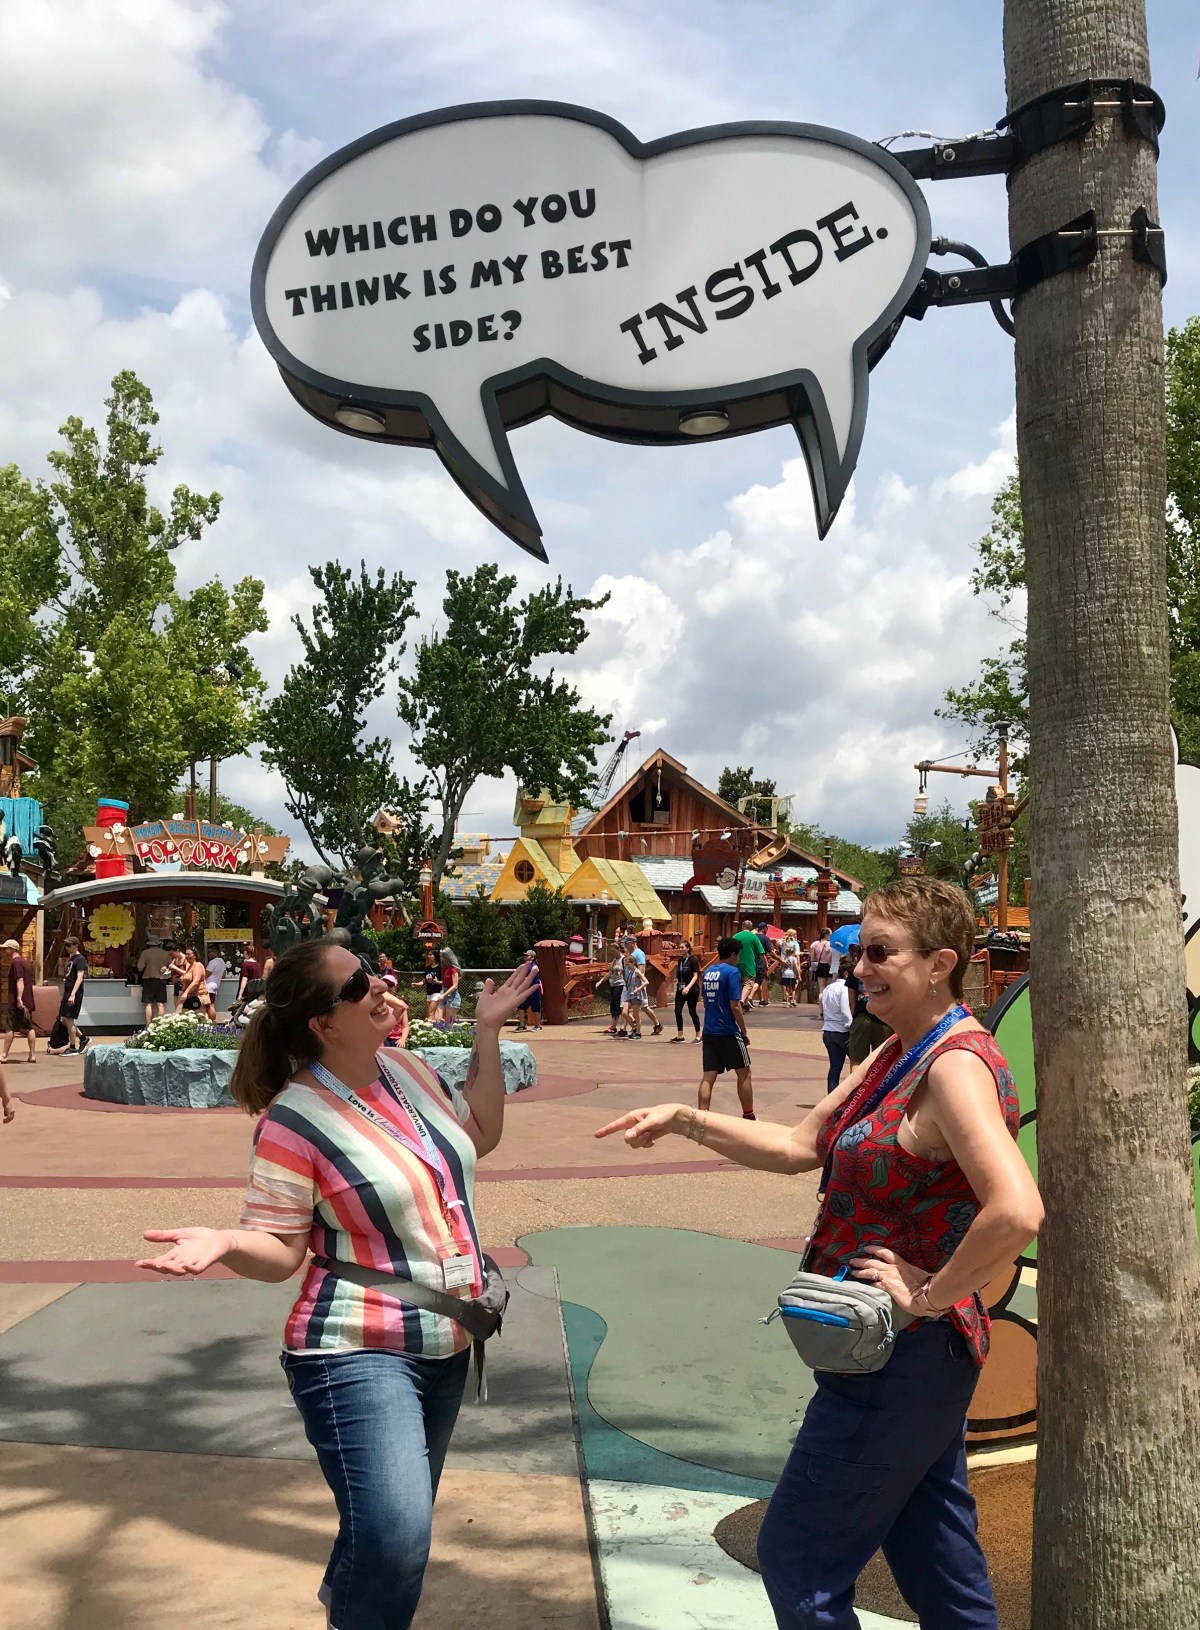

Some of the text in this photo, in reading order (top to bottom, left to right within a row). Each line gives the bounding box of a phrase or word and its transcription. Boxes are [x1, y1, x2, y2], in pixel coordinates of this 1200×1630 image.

[305, 189, 595, 256] WHICH DO YOU
[285, 240, 631, 316] THINK IS MY BEST
[620, 201, 888, 365] INSIDE.
[413, 310, 521, 352] SIDE?
[134, 823, 164, 840] POOP
[169, 821, 196, 835] DECK
[136, 839, 242, 872] POPCORN
[703, 971, 720, 981] 400
[703, 982, 719, 990] TEAM
[935, 1008, 965, 1033] STUDIOS
[840, 1045, 896, 1119] UNIVERSAL STUDIOS
[877, 1050, 913, 1091] UNIVERSAL
[347, 1094, 368, 1112] Love
[401, 1096, 427, 1138] UNIVERSAL
